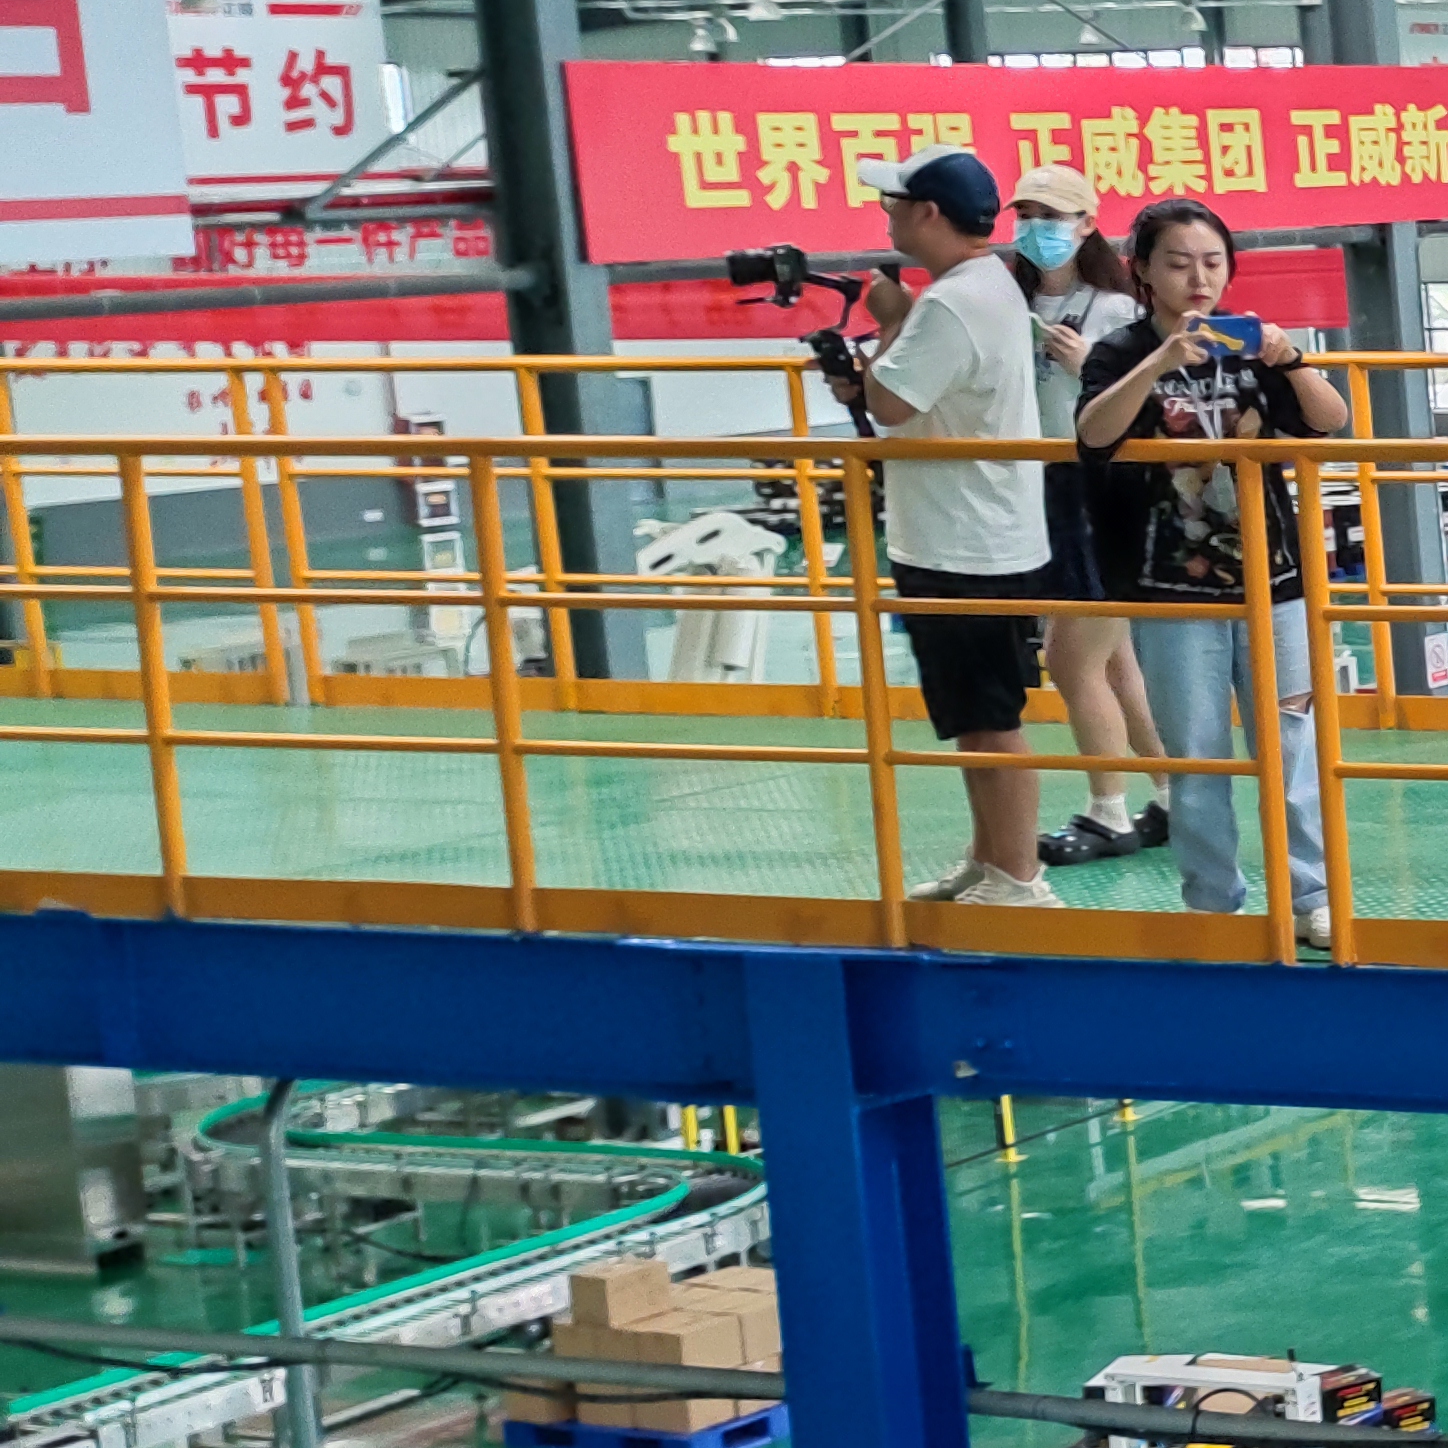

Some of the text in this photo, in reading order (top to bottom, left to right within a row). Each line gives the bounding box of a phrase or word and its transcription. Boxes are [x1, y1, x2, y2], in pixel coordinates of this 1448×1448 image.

[175, 48, 356, 140] 节约
[1009, 105, 1268, 197] 正威集团
